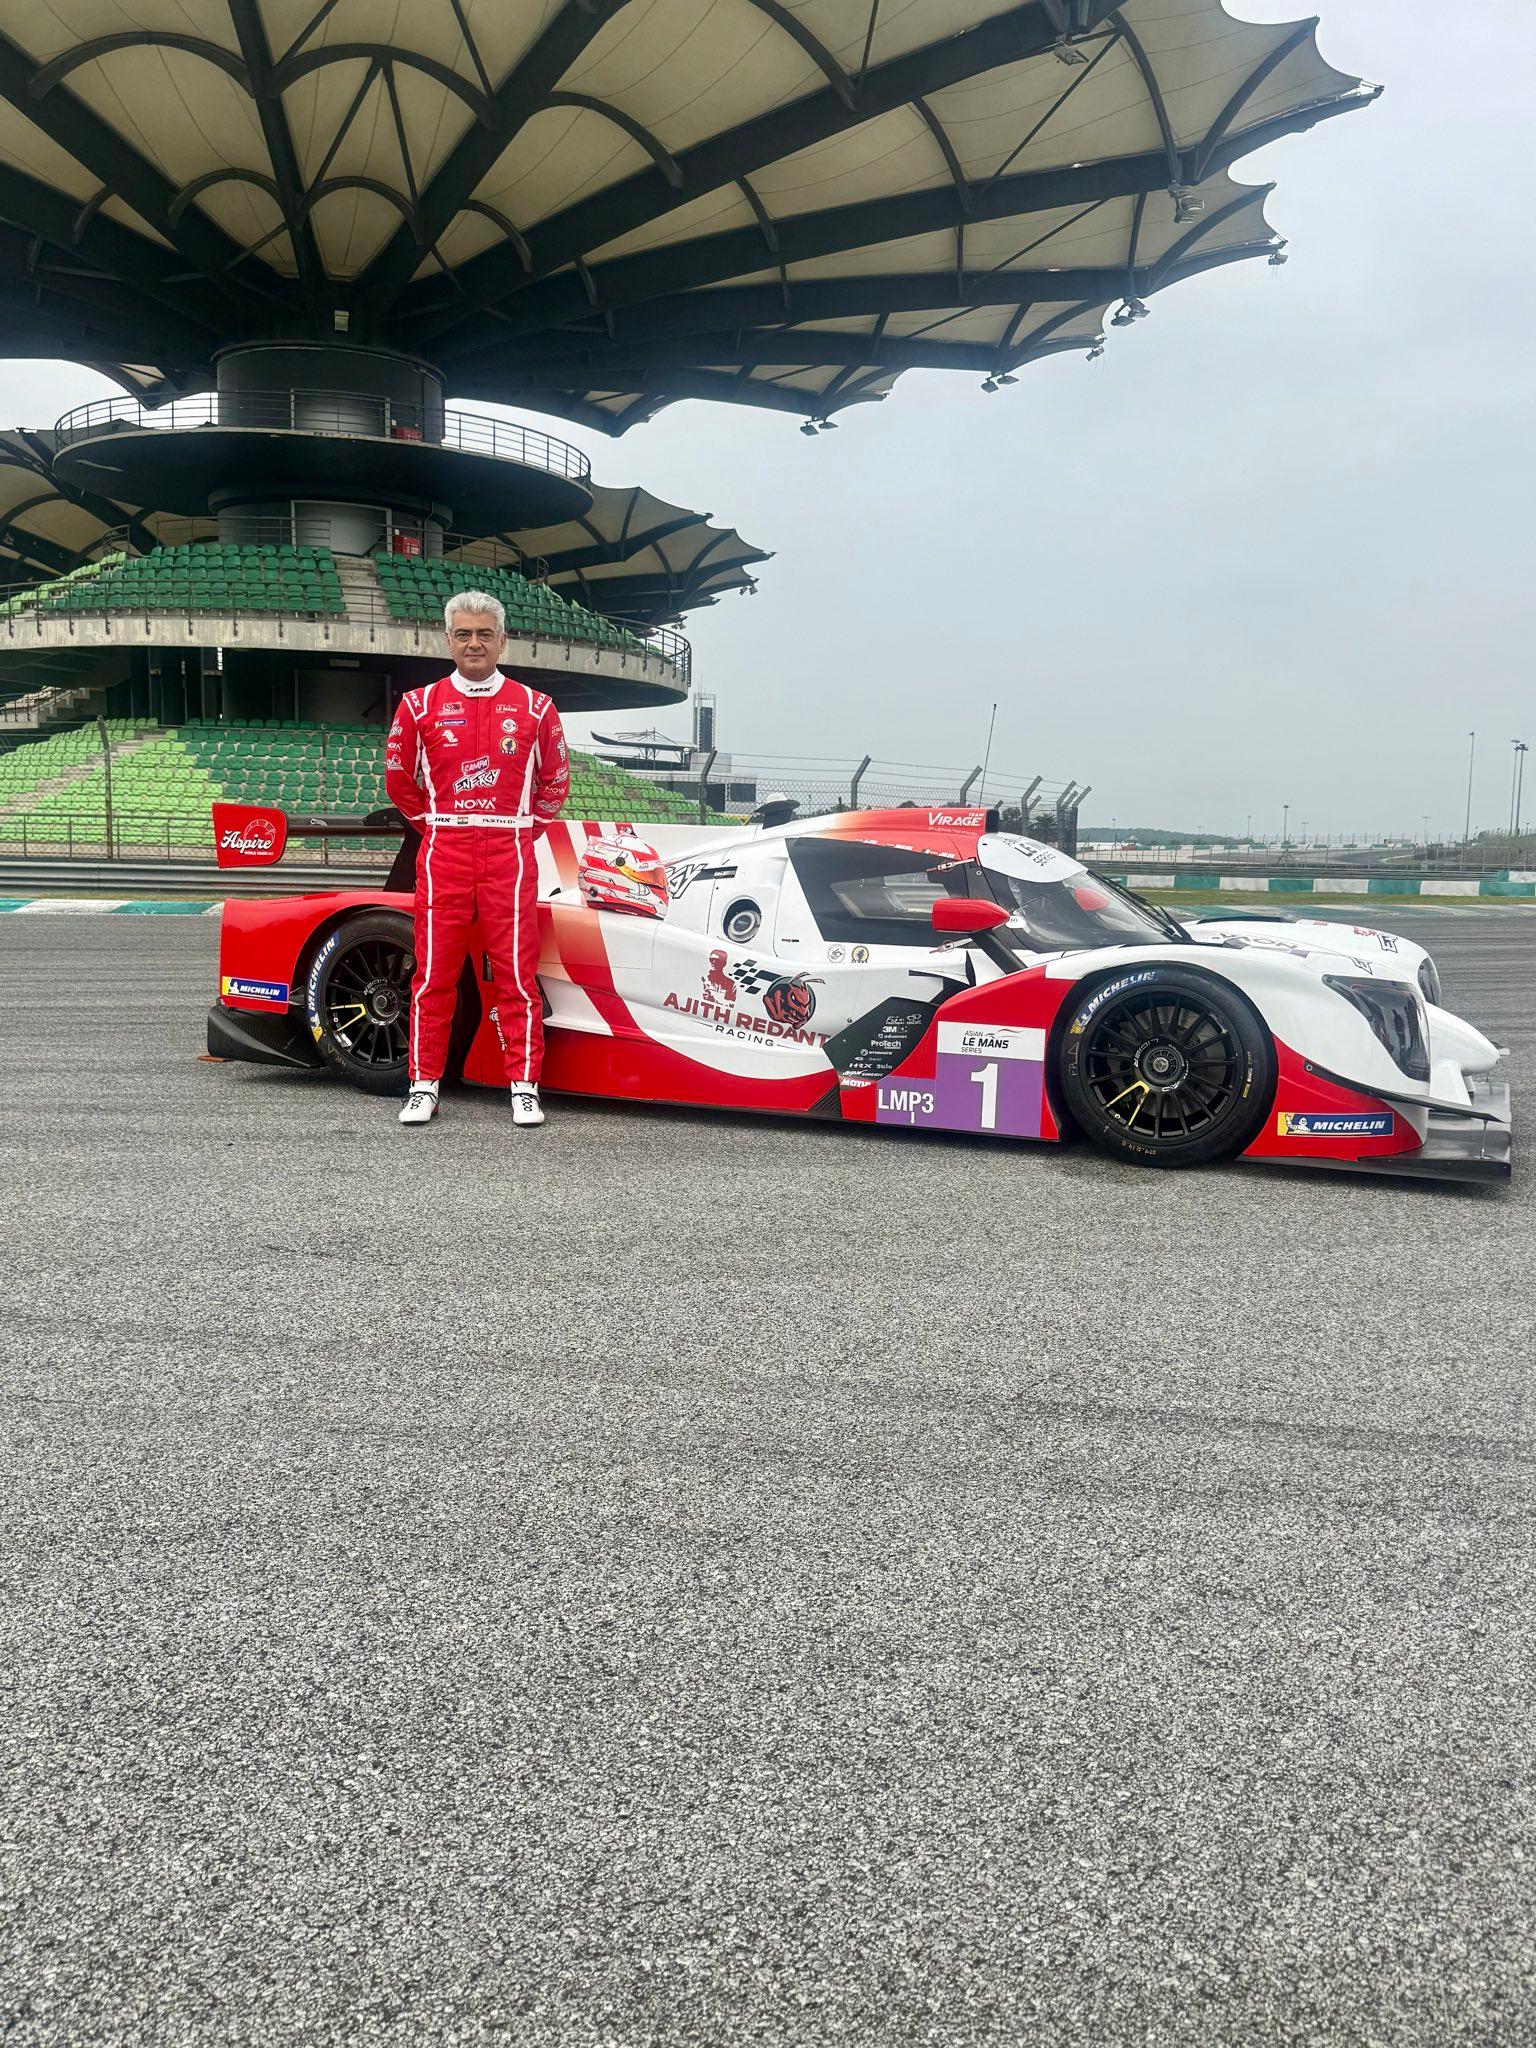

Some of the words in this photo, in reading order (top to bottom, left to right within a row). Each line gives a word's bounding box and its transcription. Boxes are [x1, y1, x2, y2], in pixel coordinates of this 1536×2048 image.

[464, 760, 488, 772] CAMPA
[454, 769, 500, 794] ENERGY
[928, 812, 983, 826] VIRAGE
[220, 830, 272, 854] Aspire
[308, 937, 336, 1011] MICHELIN
[240, 985, 280, 996] MICHELIN
[1087, 971, 1156, 1013] MICHELIN
[663, 992, 731, 1025] AJITH
[736, 1012, 832, 1048] REDANT
[714, 1024, 774, 1047] RACING
[962, 1038, 976, 1046] LE
[978, 1038, 1010, 1049] MANS
[878, 1088, 934, 1114] LMP3
[970, 1062, 998, 1129] 1
[1312, 1120, 1386, 1131] MICHELIN
